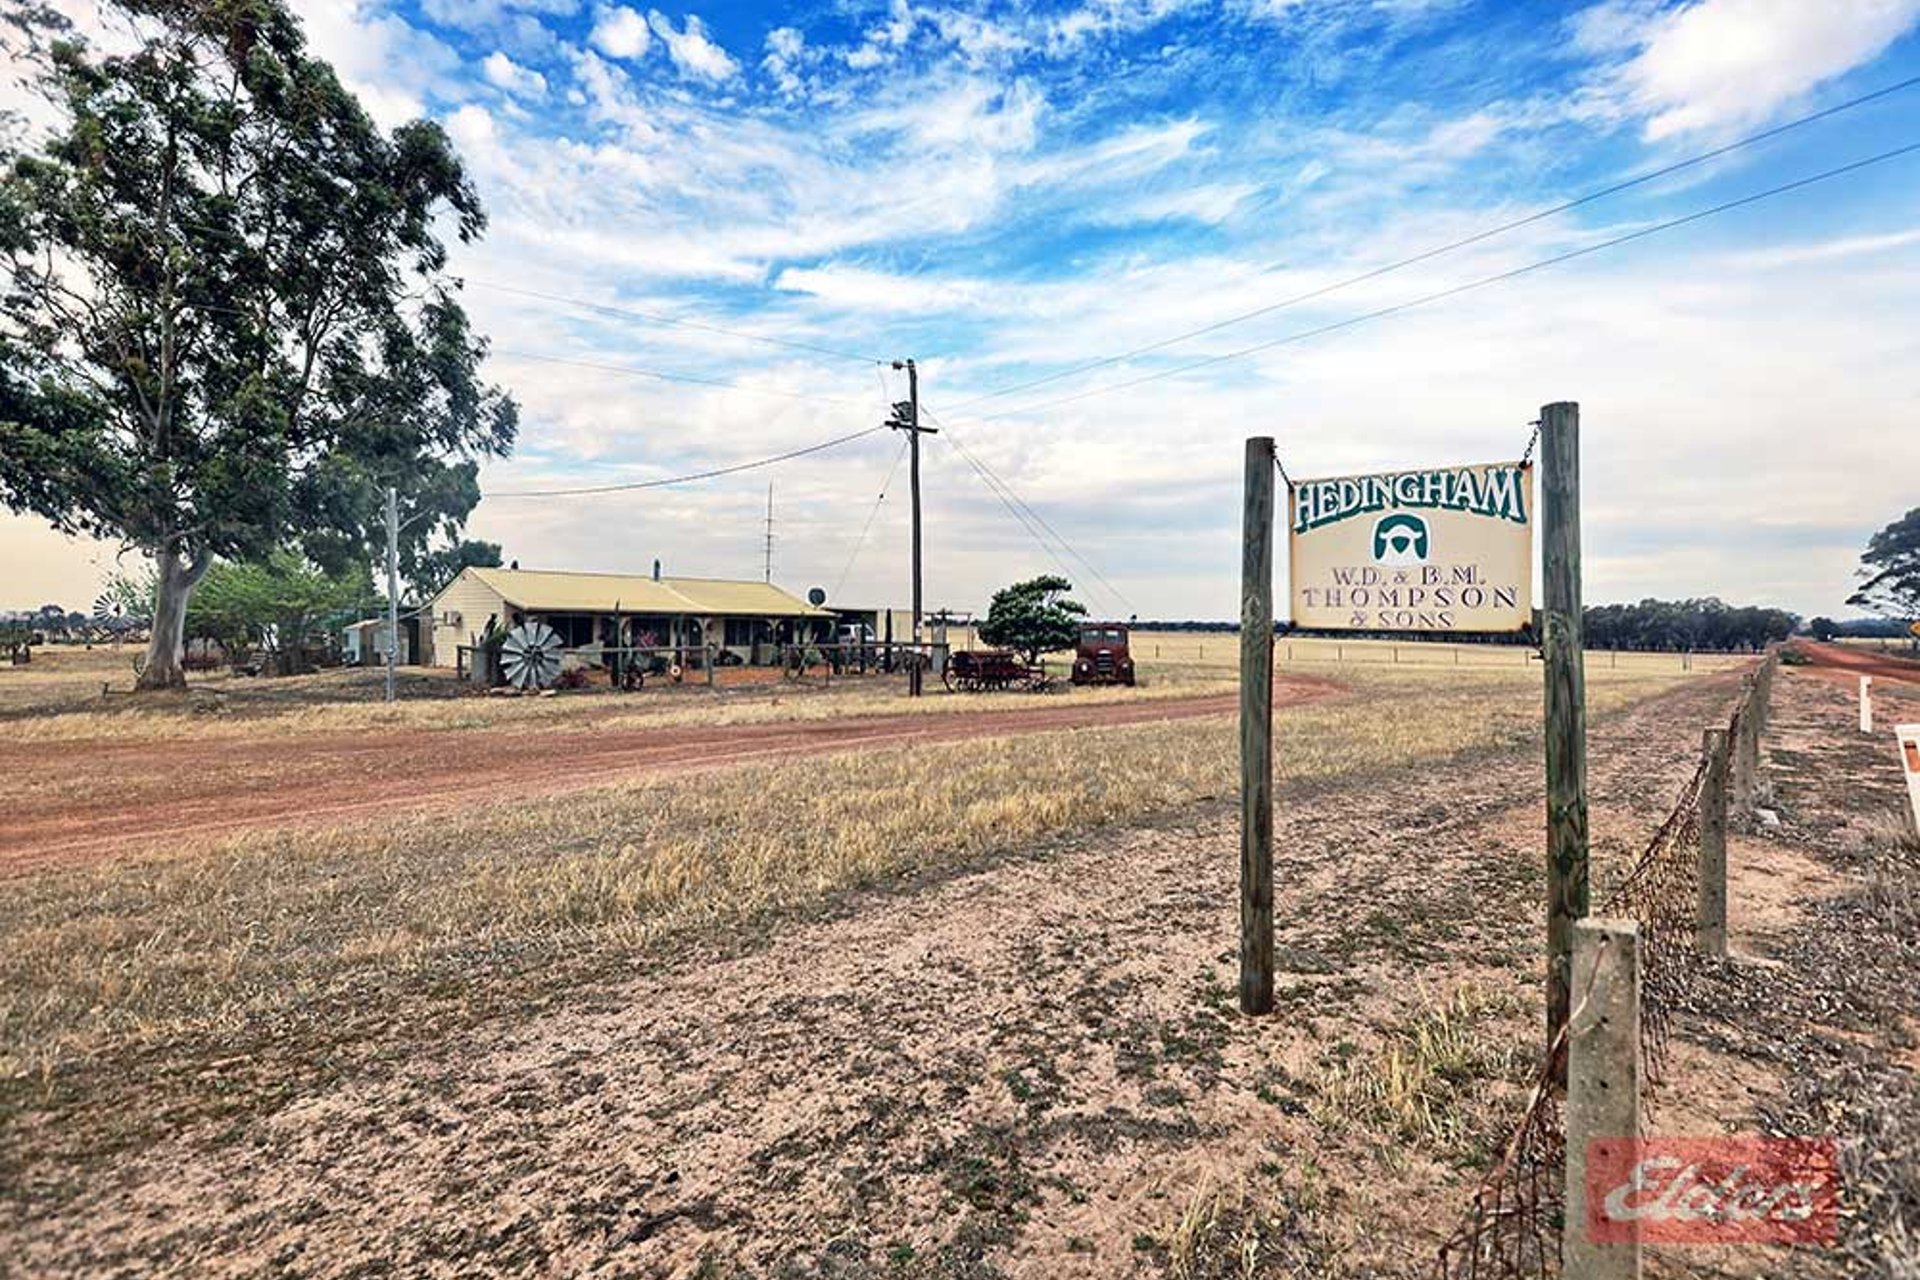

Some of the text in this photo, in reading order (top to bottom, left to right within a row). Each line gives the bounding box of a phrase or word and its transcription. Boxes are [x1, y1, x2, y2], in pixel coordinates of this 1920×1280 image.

[1293, 467, 1527, 533] HEDINGHAM
[1332, 564, 1486, 585] W.D. & B.M.
[1302, 586, 1518, 608] THOMPSON
[1350, 611, 1455, 628] & SONS
